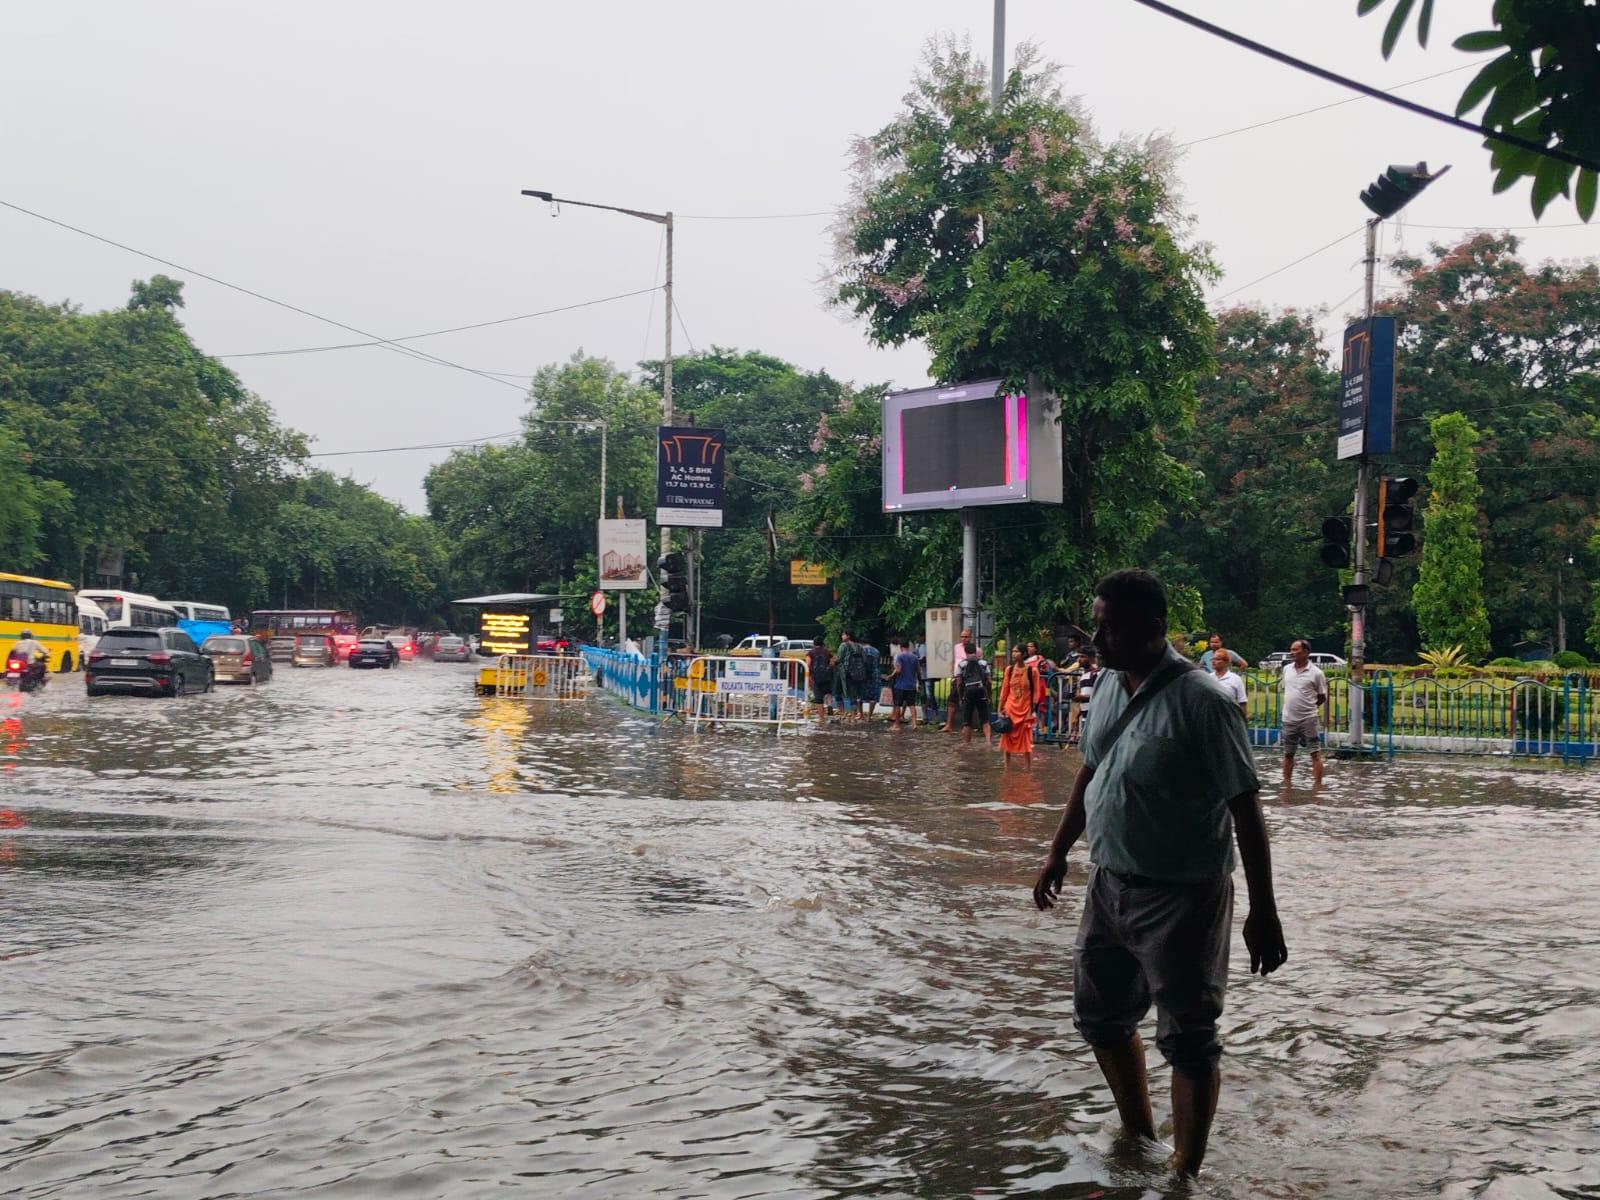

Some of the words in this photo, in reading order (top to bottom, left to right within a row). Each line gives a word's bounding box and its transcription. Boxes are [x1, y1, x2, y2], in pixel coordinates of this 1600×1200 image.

[722, 682, 743, 691] KOLKATA
[744, 682, 765, 692] TRAFFIC
[766, 683, 783, 692] POLICE
